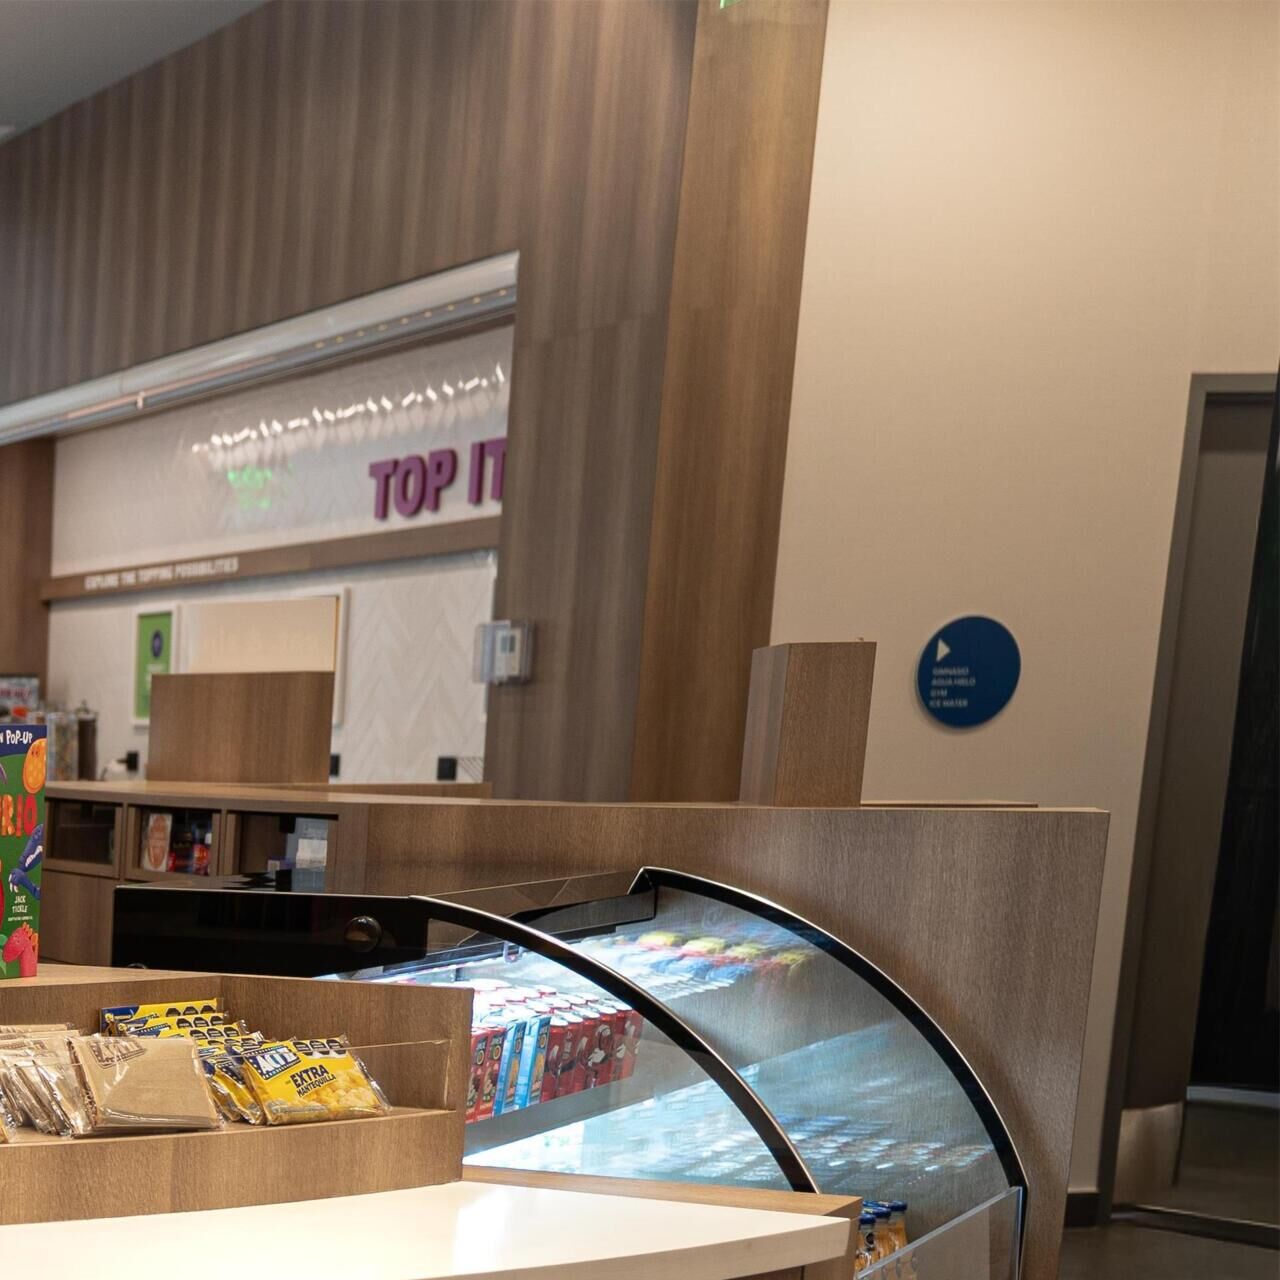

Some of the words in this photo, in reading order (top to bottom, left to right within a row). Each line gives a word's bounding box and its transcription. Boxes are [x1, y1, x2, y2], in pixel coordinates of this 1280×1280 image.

[369, 448, 457, 520] TOP
[468, 438, 507, 505] IT
[290, 1064, 329, 1087] EXTRA
[296, 1074, 336, 1096] MANTEQUILLA
